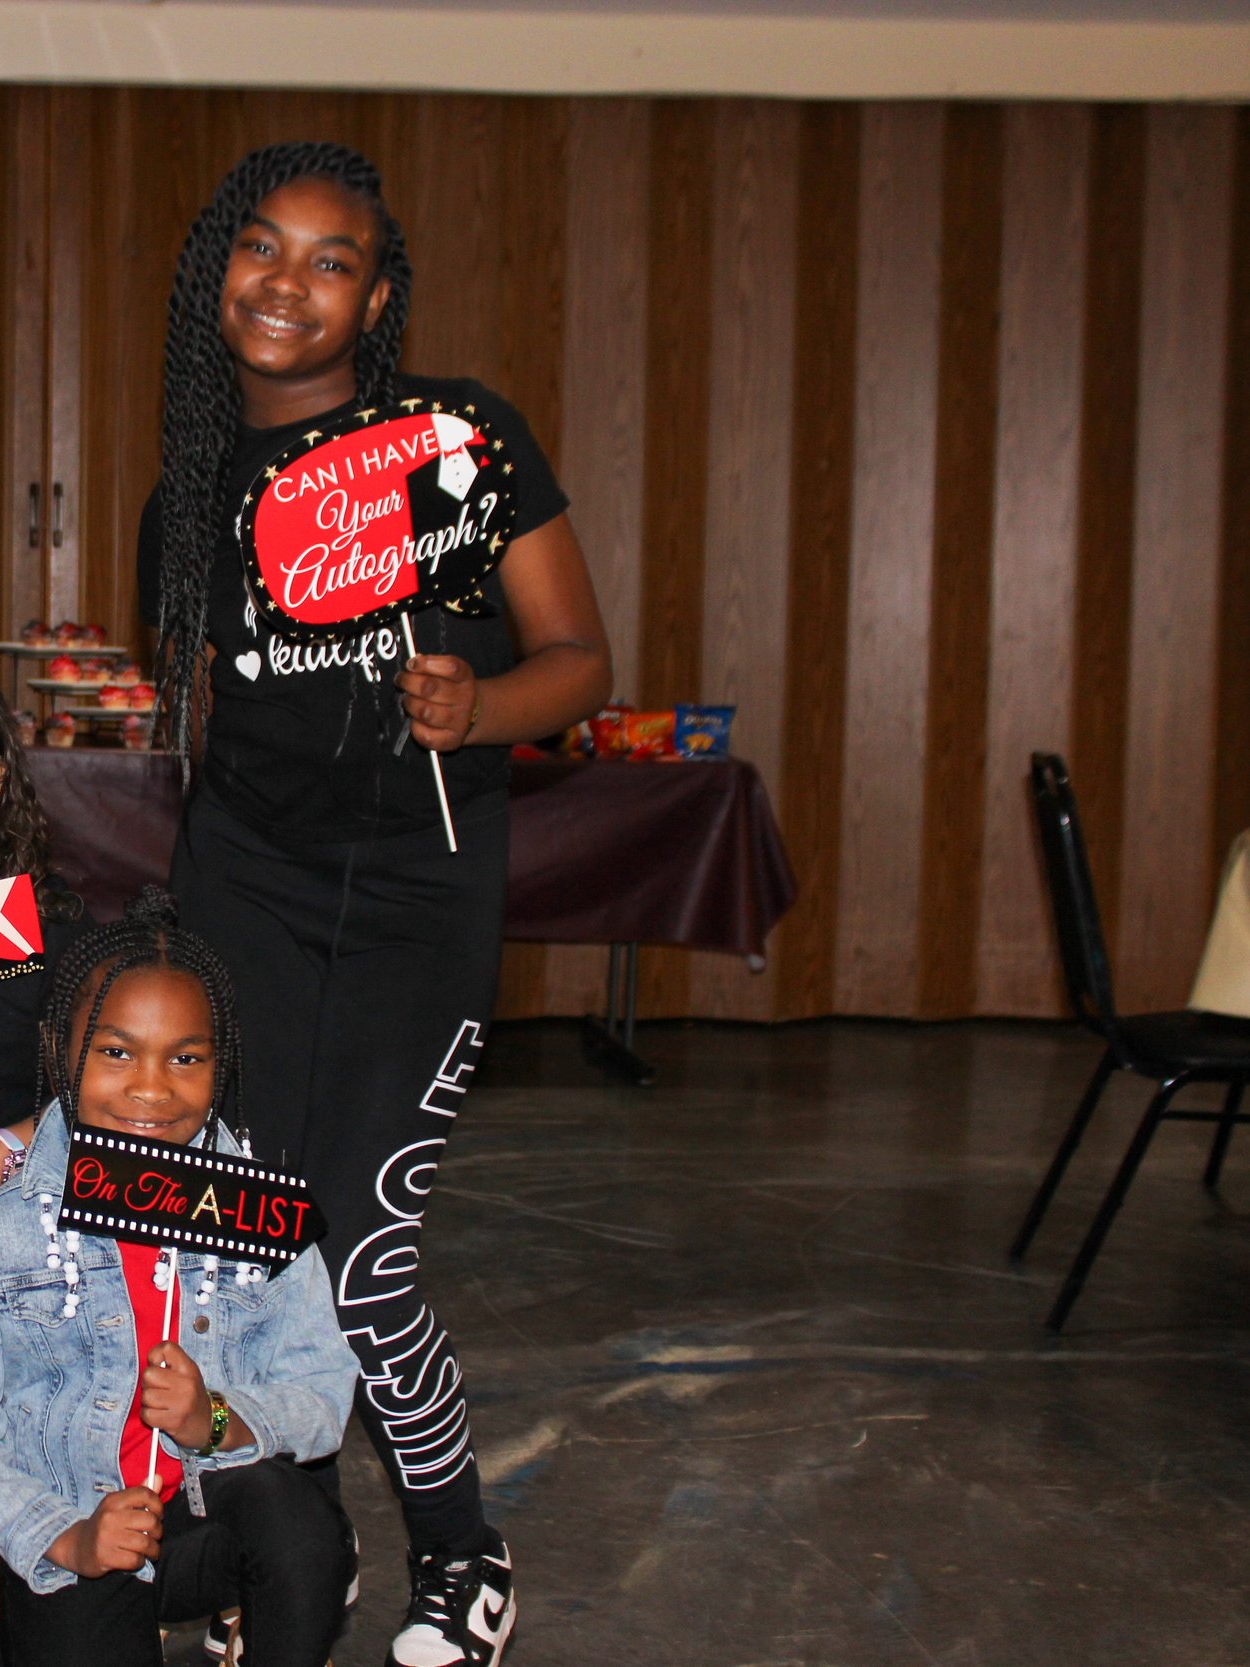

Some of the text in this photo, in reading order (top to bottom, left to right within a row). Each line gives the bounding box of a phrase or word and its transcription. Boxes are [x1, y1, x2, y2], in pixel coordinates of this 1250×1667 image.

[273, 428, 439, 502] CAN I HAVE
[280, 492, 498, 608] Autograph?
[316, 488, 404, 551] Your
[73, 1157, 311, 1241] On The A-LIST
